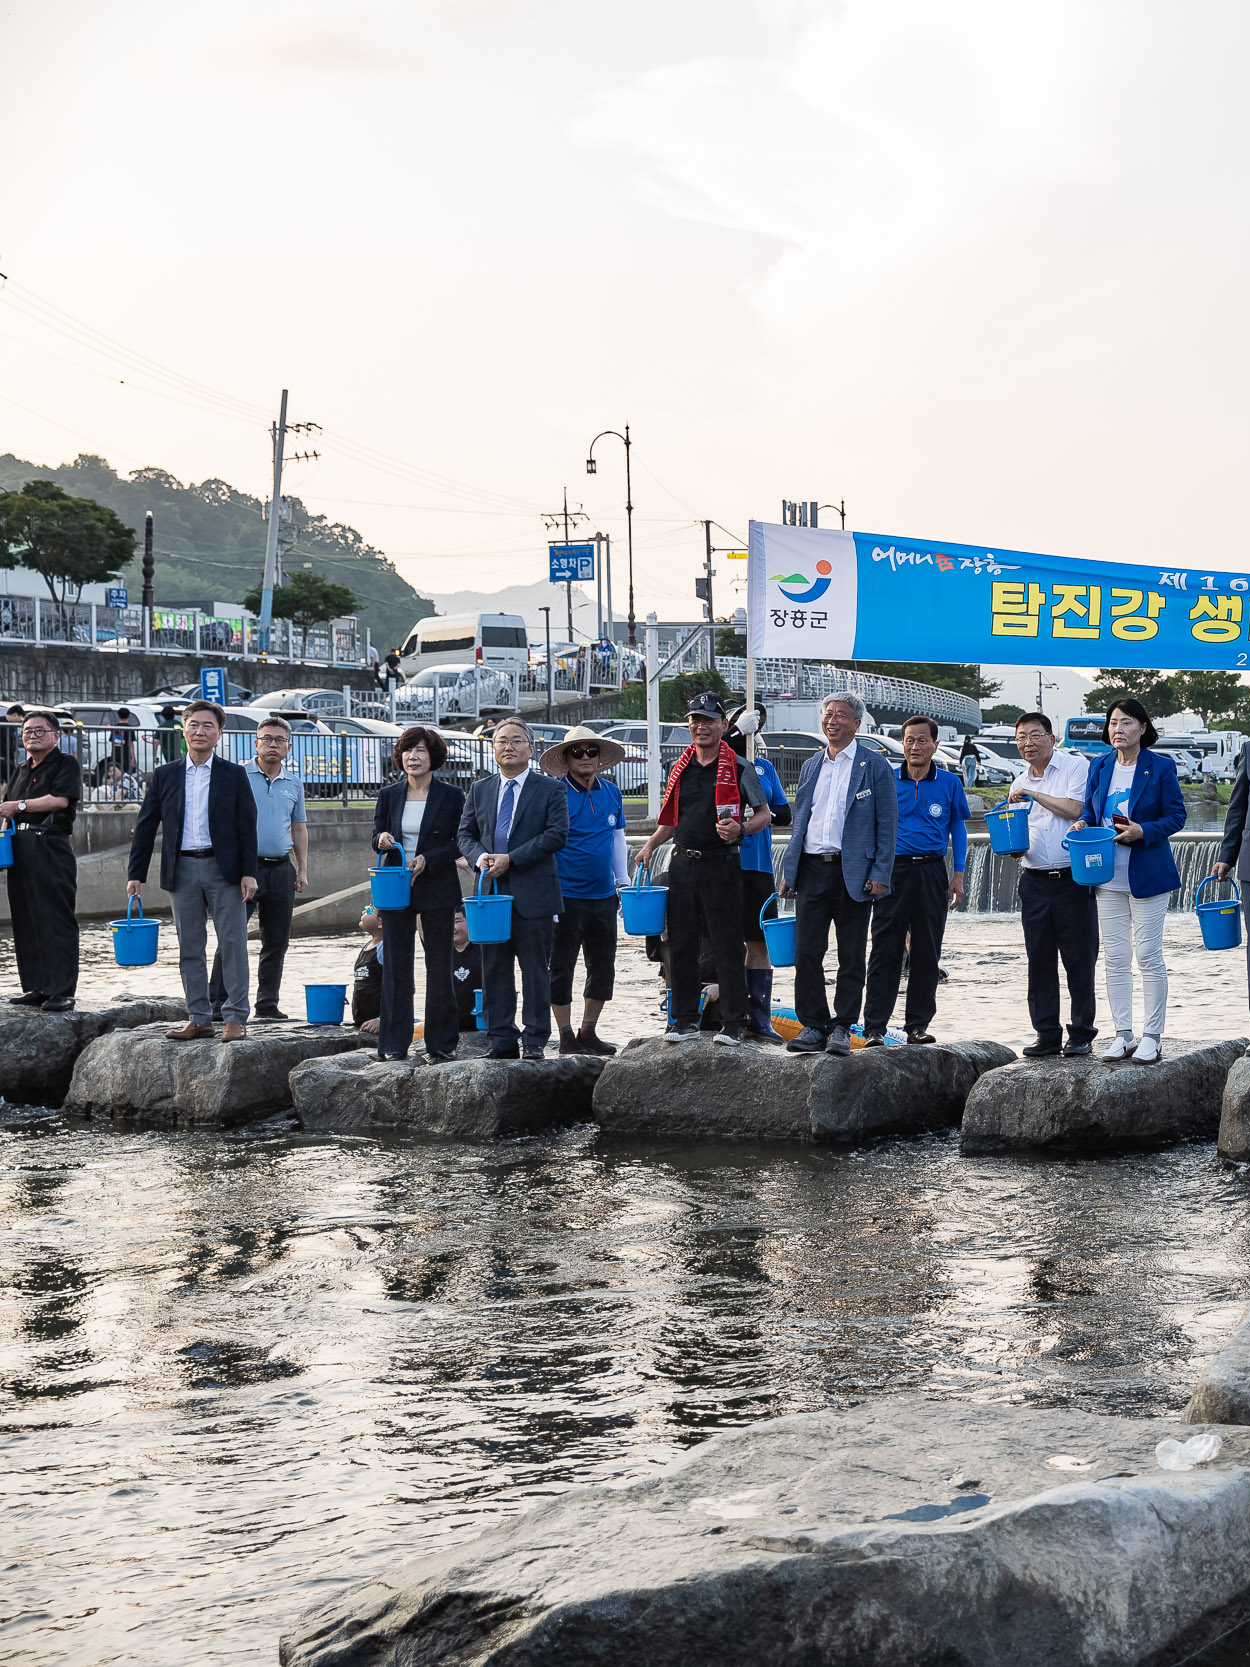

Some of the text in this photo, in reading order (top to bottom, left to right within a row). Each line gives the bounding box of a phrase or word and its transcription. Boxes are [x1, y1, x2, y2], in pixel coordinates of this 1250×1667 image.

[551, 558, 577, 569] 소형차
[957, 553, 1022, 575] 장흥
[770, 609, 828, 629] 장흥군
[991, 581, 1167, 641] 탐진강
[205, 671, 220, 702] 출구
